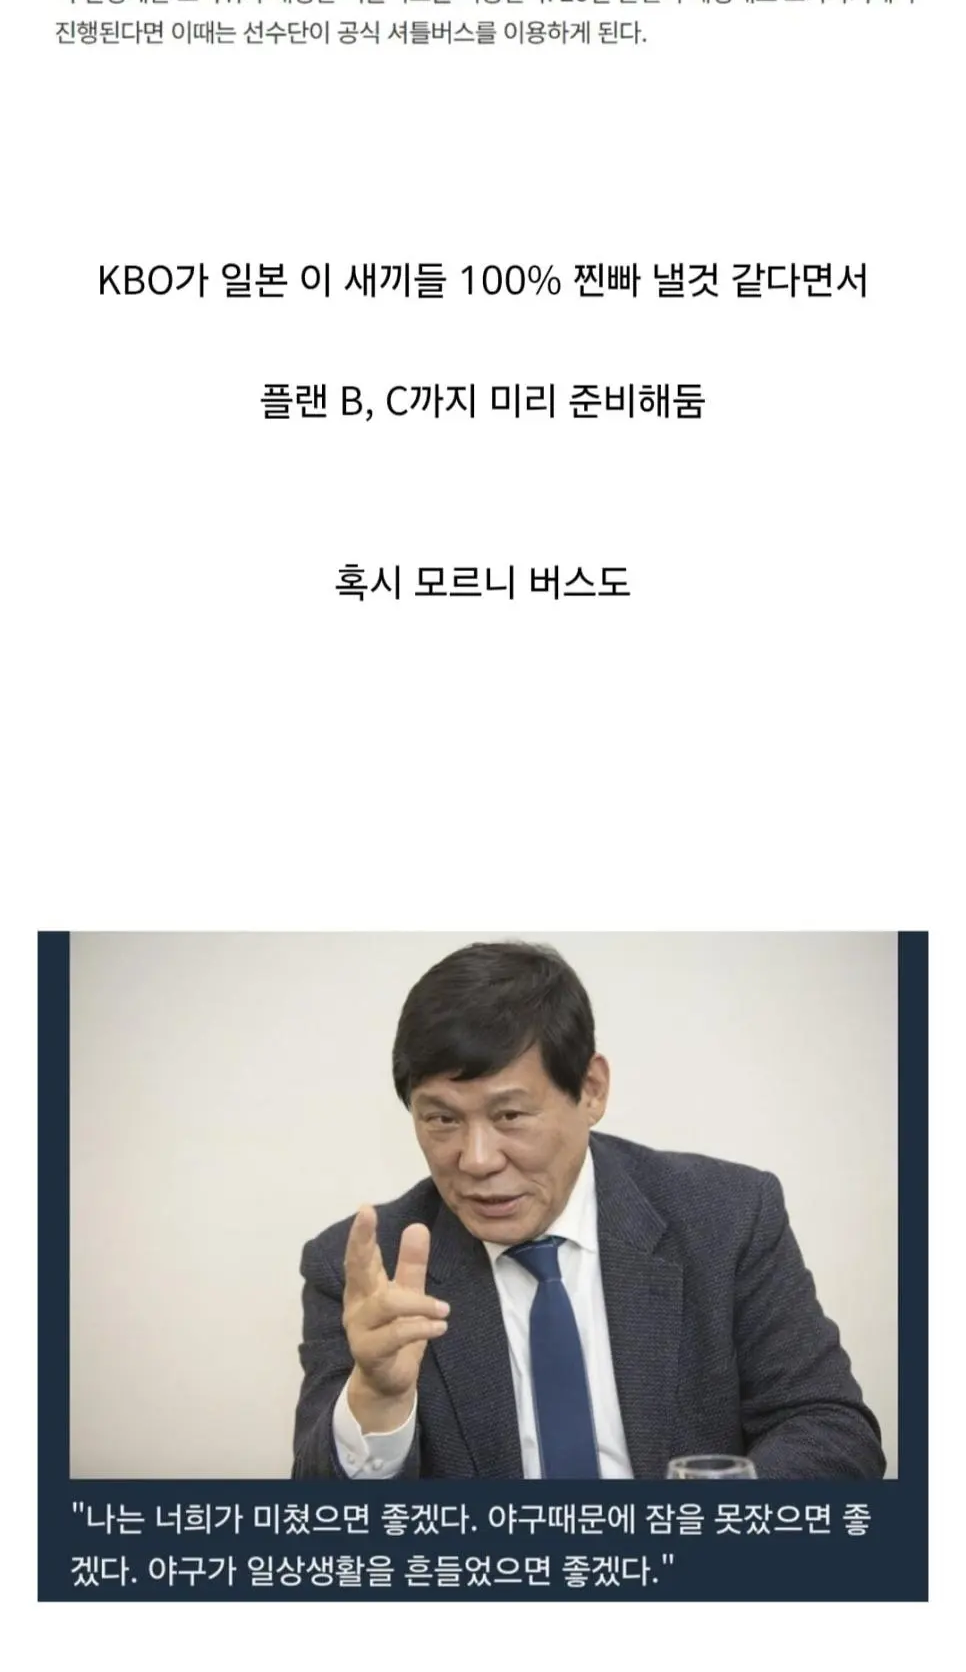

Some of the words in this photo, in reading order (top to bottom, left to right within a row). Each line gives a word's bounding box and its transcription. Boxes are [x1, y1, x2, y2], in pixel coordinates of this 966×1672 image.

[335, 564, 400, 602] 혹시
[415, 565, 514, 600] 모르니
[531, 565, 631, 600] 버스도
